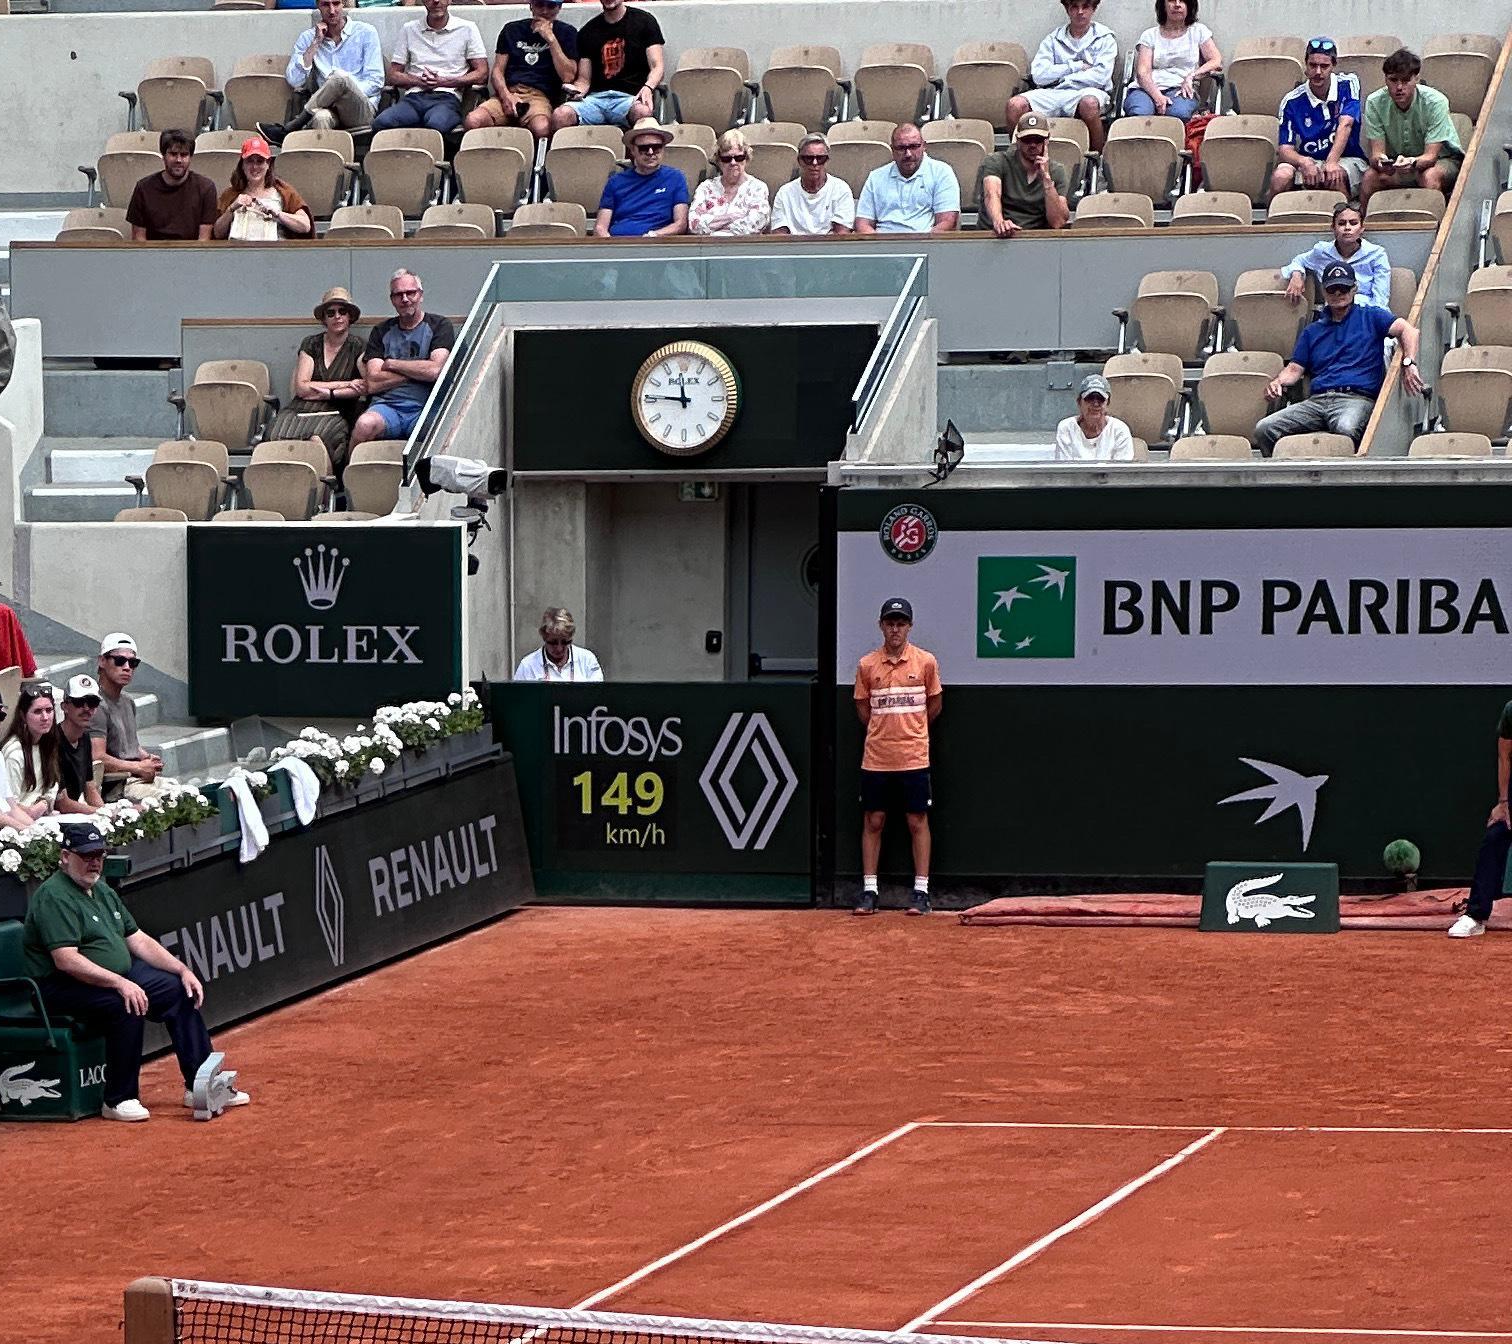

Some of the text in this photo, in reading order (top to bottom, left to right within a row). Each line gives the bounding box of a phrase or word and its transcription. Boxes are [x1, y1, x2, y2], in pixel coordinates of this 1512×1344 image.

[1103, 579, 1241, 636] BNP
[221, 623, 424, 665] ROLEX
[554, 705, 683, 762] Infosys
[573, 771, 664, 815] 149
[606, 821, 665, 848] km/h
[368, 815, 499, 917] RENAULT
